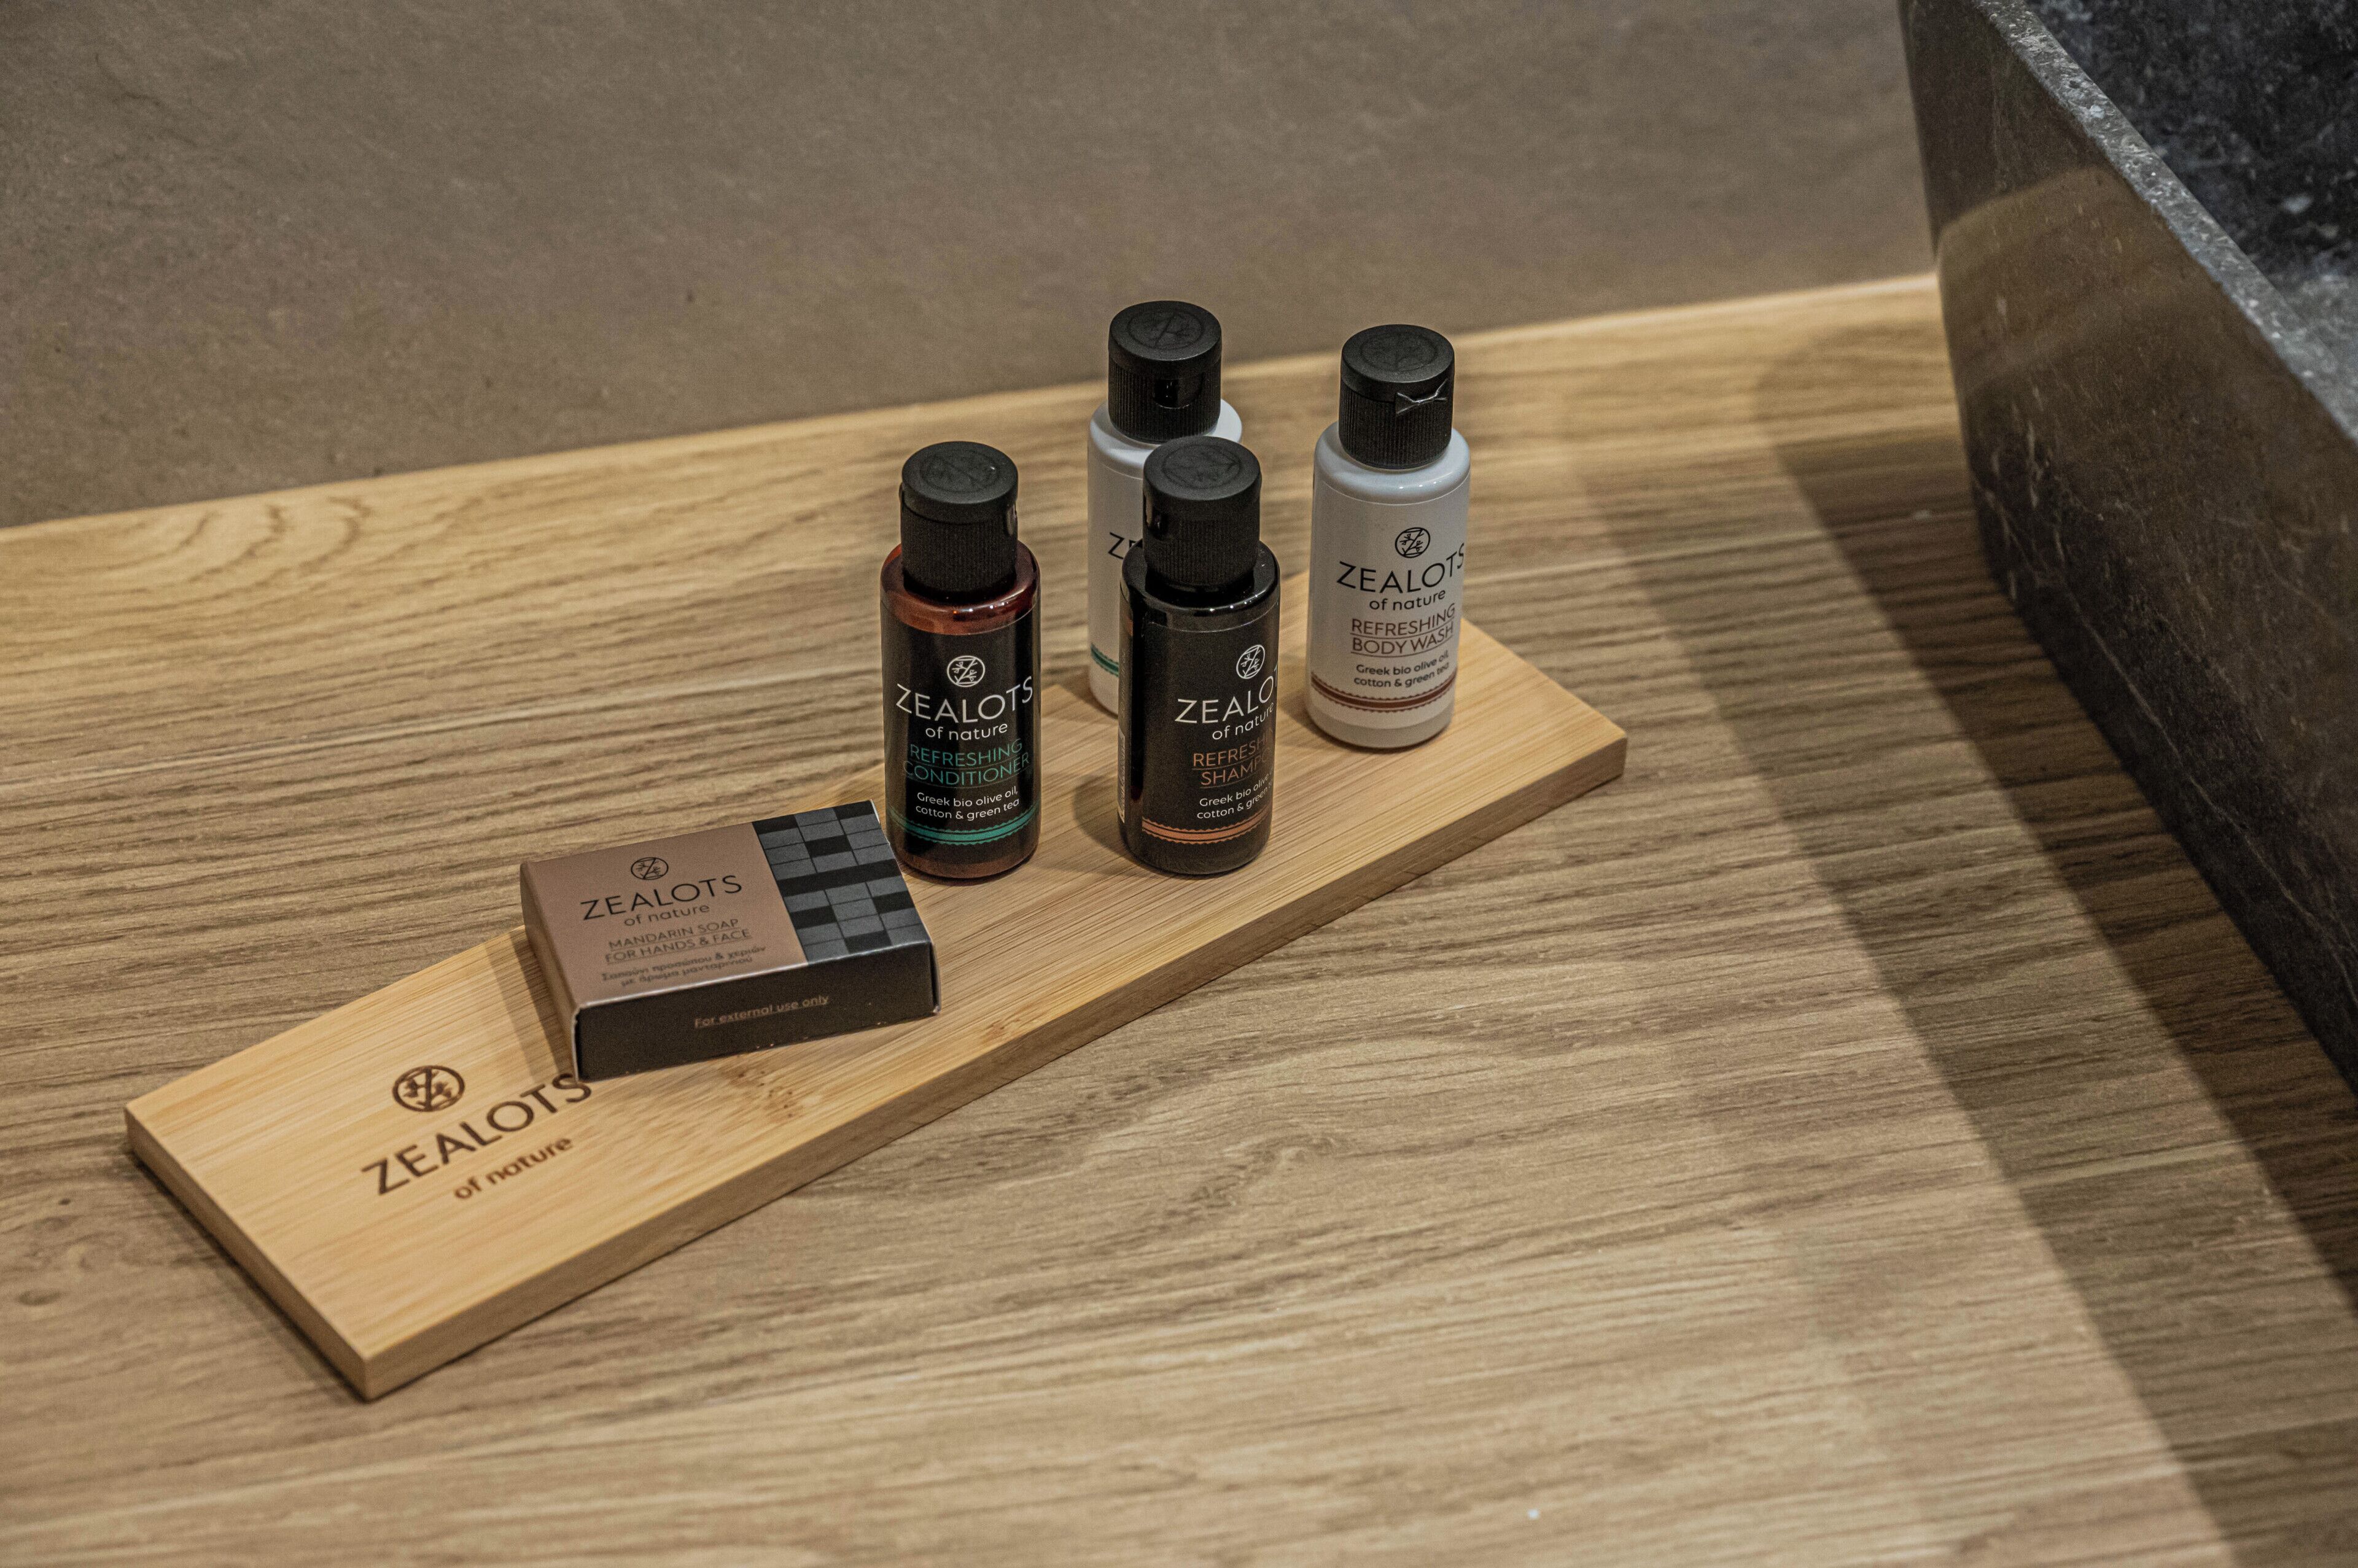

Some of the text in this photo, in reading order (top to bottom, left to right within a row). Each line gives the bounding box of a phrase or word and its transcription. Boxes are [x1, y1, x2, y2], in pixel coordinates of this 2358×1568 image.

[1337, 543, 1465, 594] ZEALOTS
[1369, 590, 1446, 611] of nature
[1352, 603, 1455, 636] REFRESHING
[1352, 621, 1453, 654] BODY WASH
[1354, 677, 1391, 688] cotton
[1394, 678, 1402, 687] &
[1405, 671, 1434, 688] green
[1356, 664, 1389, 675] Greek
[1393, 666, 1411, 675] bio
[1414, 658, 1437, 672] olive
[896, 675, 1033, 724] ZEALOTS
[925, 723, 1008, 741] of nature
[1212, 702, 1274, 740] of nature
[903, 752, 1029, 786] CONDITIONER
[910, 738, 1022, 767] REFRESHING
[917, 786, 1018, 807] Greek bio olive oil,
[1197, 787, 1267, 819] cotton & green
[1199, 794, 1233, 807] Greek
[1236, 788, 1251, 800] bio
[1253, 773, 1269, 791] olive
[916, 798, 1019, 821] cotton & green tea
[580, 875, 742, 920] ZEALOTS
[624, 904, 710, 926] of nature
[605, 928, 751, 963] FOR HANDS & FACE
[609, 918, 738, 949] MANDARIN SOAP
[714, 952, 725, 960] &
[695, 995, 829, 1029] For external use only
[361, 1073, 593, 1196] ZEALOTS
[453, 1138, 574, 1200] of nature
